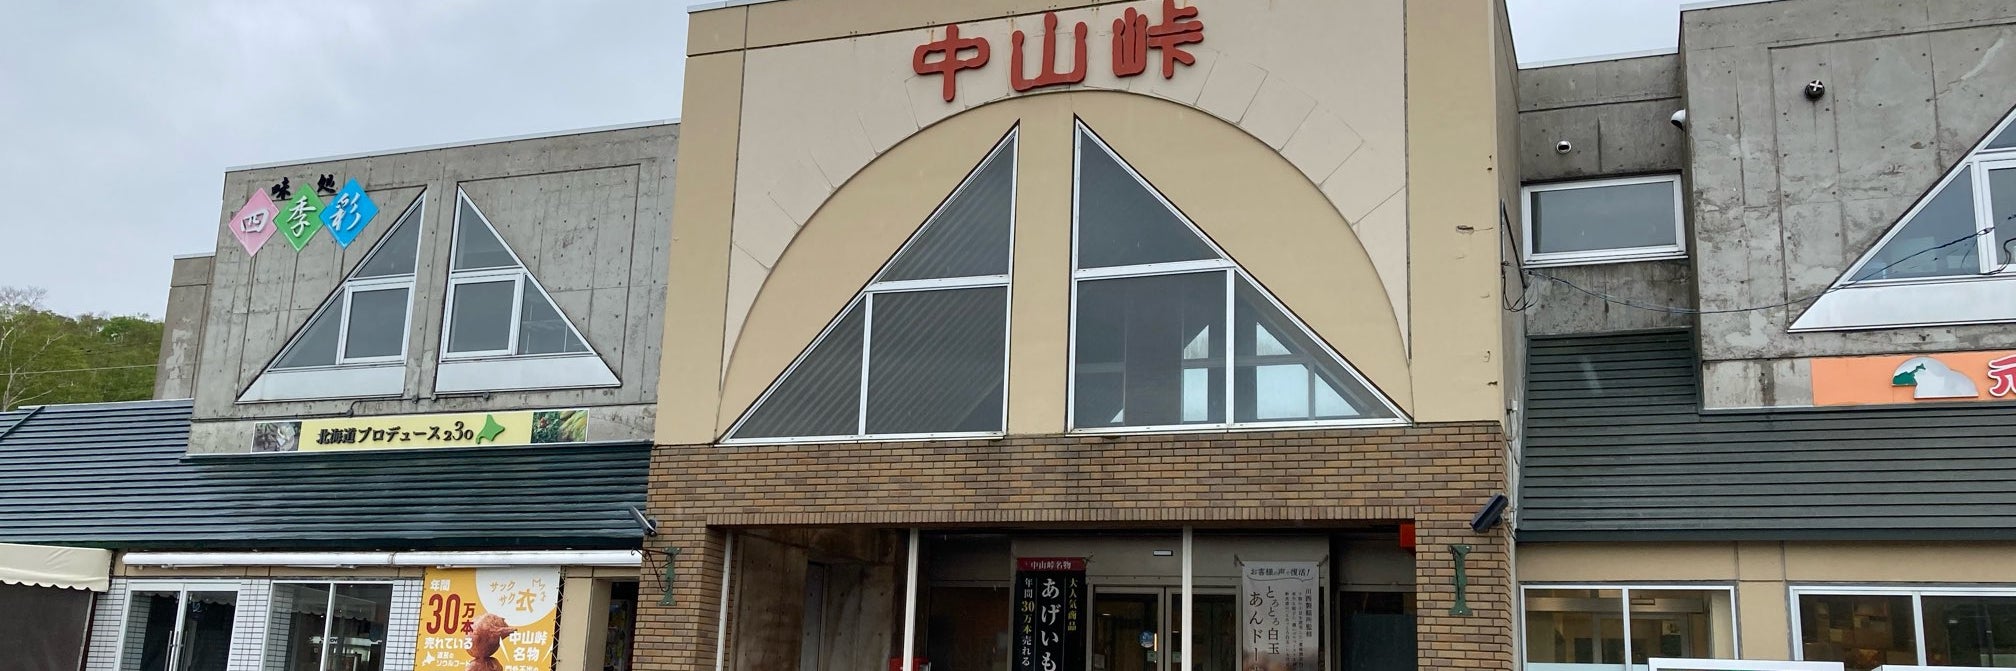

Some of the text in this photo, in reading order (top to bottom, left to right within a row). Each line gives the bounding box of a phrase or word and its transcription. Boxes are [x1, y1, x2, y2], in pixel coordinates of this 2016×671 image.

[913, 0, 1204, 103] 中山峠
[271, 173, 337, 200] 味処
[240, 191, 362, 238] 四季彩
[316, 420, 474, 444] 北海道プロデュース230
[1030, 561, 1072, 569] 中山峠名物
[430, 579, 450, 591] 年間
[516, 588, 537, 613] 衣
[1067, 577, 1078, 631] 大人気商品
[1021, 577, 1035, 667] 年間30万本売れる
[1041, 578, 1061, 671] あげいも
[1266, 585, 1280, 655] とろとろ白玉
[424, 637, 473, 650] 売れている
[509, 631, 548, 646] 中山峠
[513, 647, 540, 662] 名物
